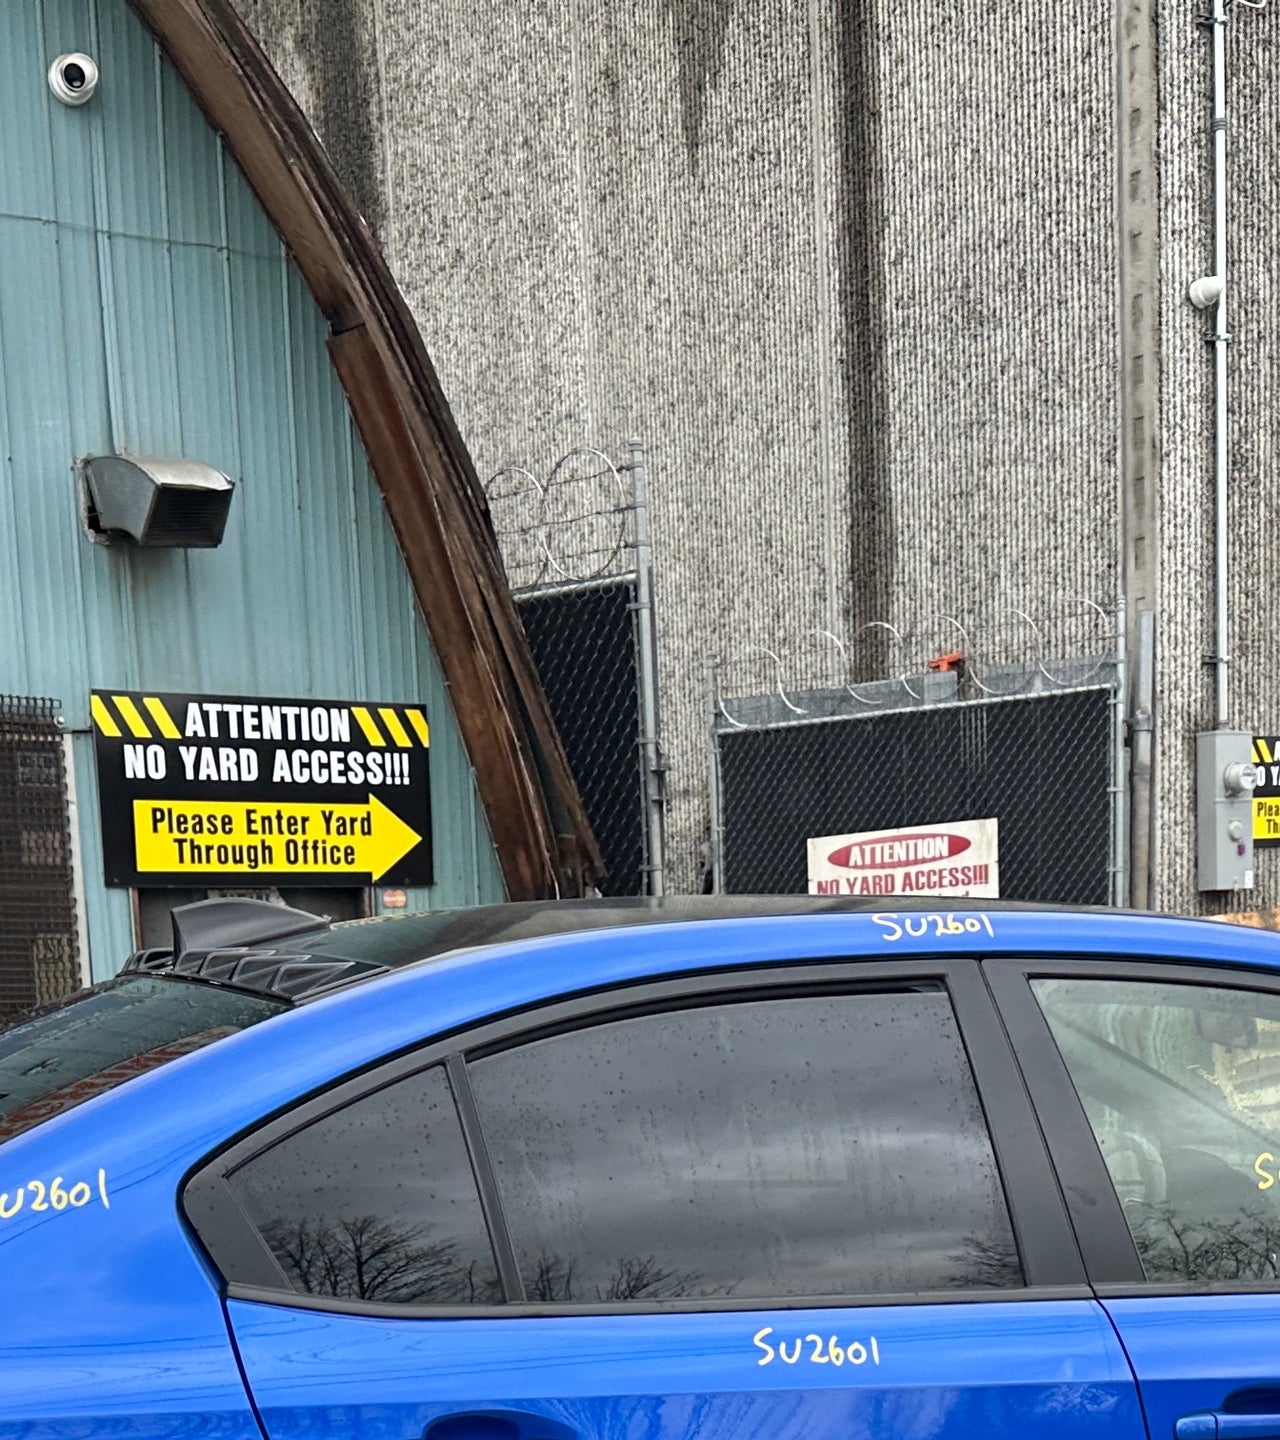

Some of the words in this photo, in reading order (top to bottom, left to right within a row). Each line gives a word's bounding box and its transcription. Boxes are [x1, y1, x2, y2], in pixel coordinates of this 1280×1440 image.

[185, 702, 351, 743] ATTENTION
[123, 744, 166, 780] NO
[178, 745, 258, 782] YARD
[272, 749, 410, 785] ACCESS!!!
[151, 807, 234, 835] Please
[246, 808, 310, 836] Enter
[321, 810, 372, 837] Yard
[173, 837, 274, 870] Through
[285, 840, 356, 866] Office
[848, 836, 950, 867] ATTENTION
[817, 880, 840, 895] NO
[846, 874, 895, 895] YARD
[902, 864, 989, 892] ACCESS!!!
[872, 912, 995, 942] SU2601
[753, 1327, 880, 1367] SU2601
